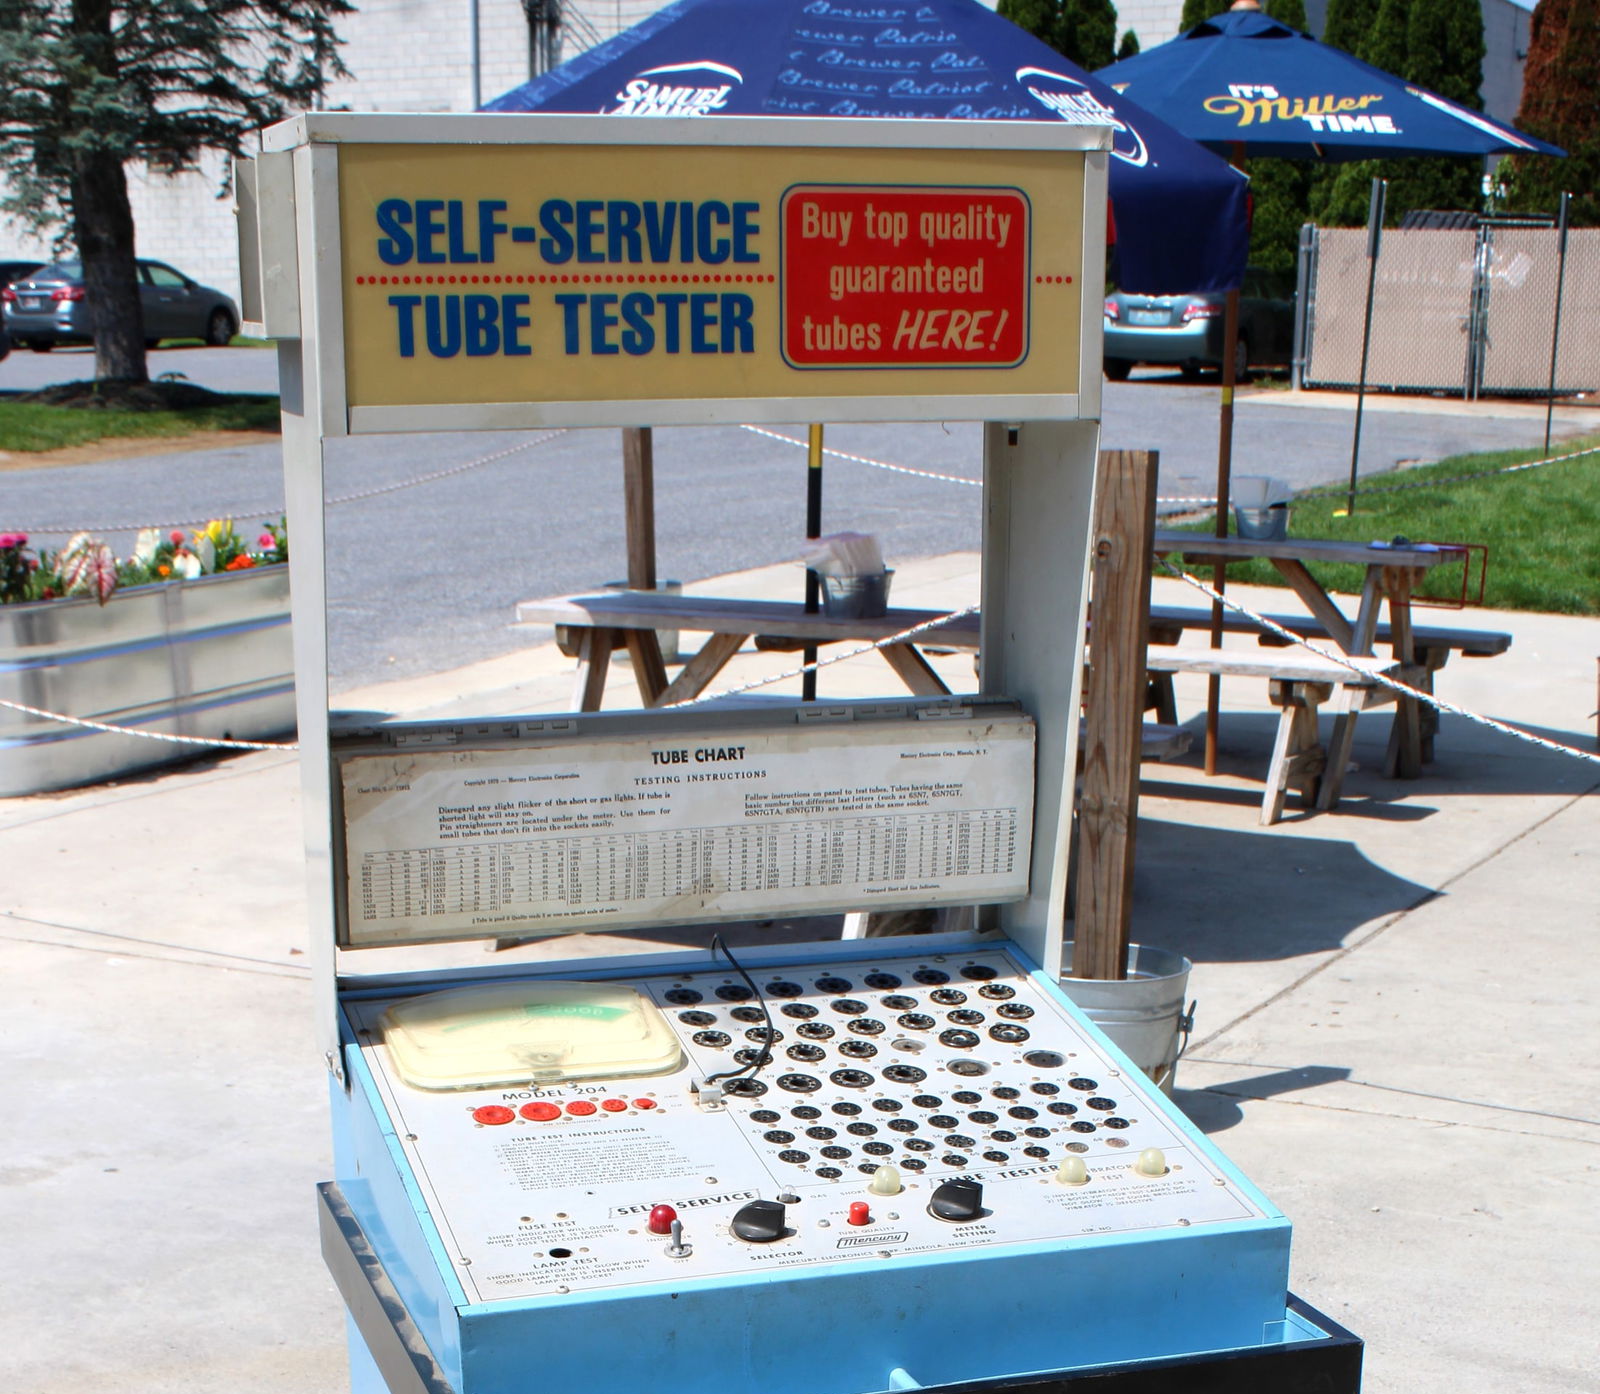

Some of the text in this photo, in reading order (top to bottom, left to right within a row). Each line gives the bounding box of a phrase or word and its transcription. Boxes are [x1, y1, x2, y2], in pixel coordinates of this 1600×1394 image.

[816, 48, 923, 71] Brewer
[777, 68, 993, 97] Brewer Patriot
[616, 79, 732, 109] SAMUEL
[1228, 84, 1279, 99] IT'S
[1203, 94, 1383, 127] Miller
[376, 199, 761, 267] SELF-SERVICE
[801, 203, 1011, 249] Buy top quality
[829, 259, 985, 300] guaranteed
[388, 291, 755, 358] TUBE TESTER
[802, 308, 1010, 352] tubes HERE!
[651, 746, 746, 765] TUBE CHART
[634, 769, 767, 786] TESTING INSTRUCTIONS
[745, 793, 768, 803] Follow
[771, 790, 811, 801] instructions
[824, 788, 843, 799] panel
[855, 786, 868, 795] test
[869, 785, 889, 795] tubes.
[891, 784, 910, 793] Tubes
[911, 783, 933, 793] having
[935, 781, 946, 790] the
[946, 782, 963, 790] same
[438, 804, 475, 815] Disregard
[478, 805, 491, 813] any
[494, 801, 514, 812] slight
[518, 799, 541, 809] flicker
[545, 799, 552, 807] of
[556, 798, 567, 807] the
[570, 797, 587, 806] short
[600, 796, 612, 804] gas
[614, 793, 636, 804] lights.
[638, 792, 645, 800] If
[647, 791, 662, 800] tube
[665, 791, 671, 799] is
[744, 801, 763, 811] basic
[764, 800, 790, 809] number
[792, 798, 804, 807] but
[805, 796, 836, 806] different
[838, 796, 850, 805] last
[852, 794, 874, 803] letters
[878, 793, 896, 802] (such
[842, 803, 863, 812] tested
[866, 802, 872, 810] in
[874, 801, 885, 810] the
[887, 801, 905, 809] same
[907, 799, 930, 808] socket.
[439, 813, 467, 823] shorted
[469, 811, 485, 821] light
[488, 811, 502, 820] will
[504, 810, 519, 818] stay
[440, 823, 453, 831] Pin
[455, 820, 502, 830] straighteners
[522, 816, 549, 825] located
[551, 814, 573, 823] under
[577, 813, 588, 821] the
[593, 812, 616, 820] meter.
[620, 810, 634, 818] Use
[638, 809, 656, 817] them
[660, 807, 671, 816] for
[439, 819, 614, 840] small tubes that don't fit into the sockets easily.
[501, 1085, 608, 1101] MODEL 204
[568, 1126, 646, 1138] INSTRUCTIONS
[997, 1164, 1060, 1179] TESTER
[1087, 1163, 1133, 1174] IBRATOR
[1101, 1173, 1124, 1182] TEST
[676, 1191, 754, 1209] SERVICE
[840, 1189, 866, 1197] SHORT
[518, 1220, 577, 1232] FUSE TEST
[580, 1228, 620, 1236] TOUCHED
[860, 1226, 896, 1234] QUALITY
[952, 1229, 997, 1239] SETTING
[955, 1224, 987, 1233] METER
[487, 1233, 515, 1241] SHORT
[518, 1229, 564, 1238] INDICATOR
[518, 1240, 539, 1248] FUSE
[778, 1256, 818, 1266] MERCURY
[821, 1251, 874, 1262] ELECTRONICS
[970, 1238, 993, 1246] YORK
[533, 1257, 599, 1270] LAMP TEST
[750, 1250, 804, 1262] SELECTOR
[486, 1273, 515, 1282] SHORT
[519, 1268, 567, 1278] INDICATOR
[593, 1261, 620, 1269] GLOW
[623, 1258, 650, 1266] WHEN
[496, 1277, 524, 1286] GOOD
[526, 1274, 549, 1282] LAMP
[554, 1271, 577, 1279] BULB
[591, 1265, 631, 1274] INSERTED
[534, 1279, 560, 1287] LAMP
